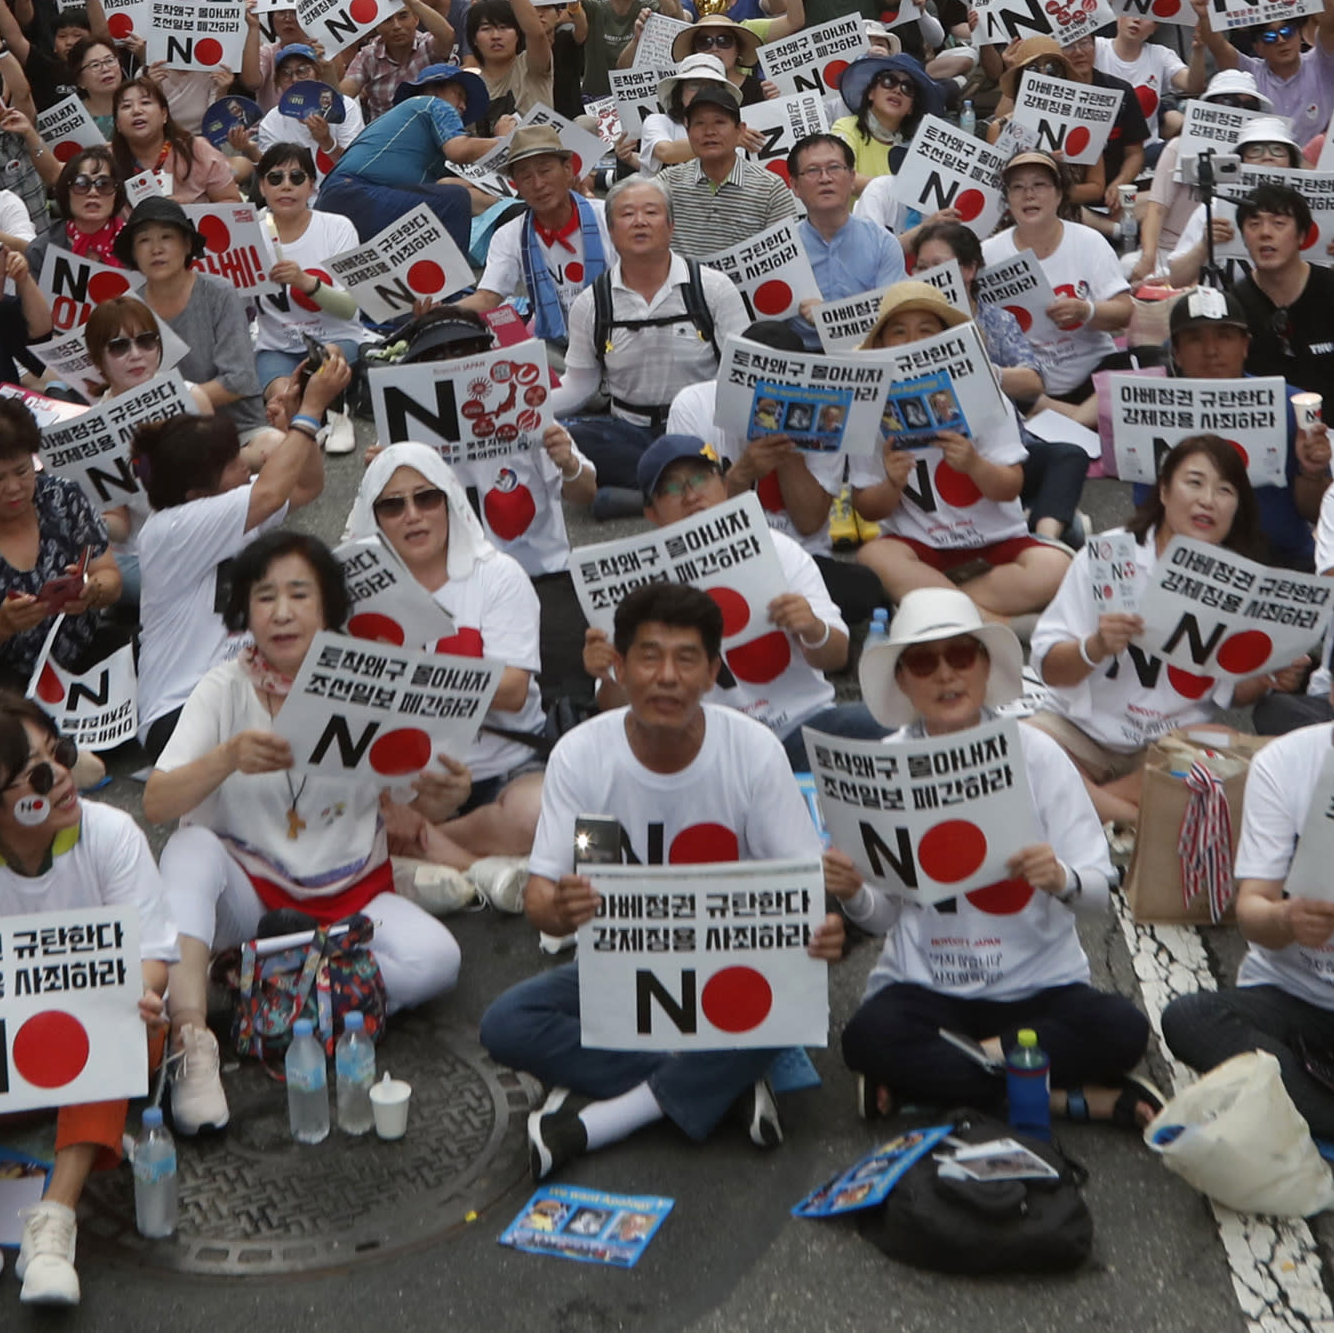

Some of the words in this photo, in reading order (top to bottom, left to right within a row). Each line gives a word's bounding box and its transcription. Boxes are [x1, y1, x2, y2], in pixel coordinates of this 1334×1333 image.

[763, 42, 815, 62] 토착왜구
[818, 22, 860, 46] 몰아내자
[769, 54, 819, 75] 조선일보
[1023, 93, 1069, 110] 강제징용
[1073, 103, 1112, 121] 사죄하라
[1027, 78, 1073, 95] 아베정권
[1077, 87, 1118, 106] 규탄한다
[331, 245, 380, 274] 아베정권
[379, 213, 430, 248] 규탄한다
[390, 229, 441, 262] 사죄하라
[1120, 386, 1193, 406] 아베정권
[1200, 389, 1275, 407] 규탄한다
[1123, 408, 1194, 428] 강제징용
[1201, 411, 1276, 429] 사죄하라
[580, 548, 660, 584] 토착왜구
[665, 509, 753, 559] 몰아내자
[1172, 546, 1254, 592] 아베정권
[1258, 576, 1331, 606] 규탄한다
[1160, 569, 1242, 612] 강제징용
[1247, 600, 1319, 629] 사죄하라
[319, 646, 408, 679] 토착왜구
[411, 664, 492, 694] 몰아내자
[305, 673, 398, 710] 조선일보
[816, 754, 899, 786] 토착왜구
[906, 736, 1008, 778] 몰아내자
[822, 778, 905, 813] 조선일보
[593, 894, 695, 919] 아베정권
[705, 891, 811, 919] 규탄한다
[13, 921, 124, 957] 규탄한다
[592, 925, 696, 952] 강제징용
[705, 924, 811, 950] 사죄하라
[15, 959, 126, 998] 사죄하라
